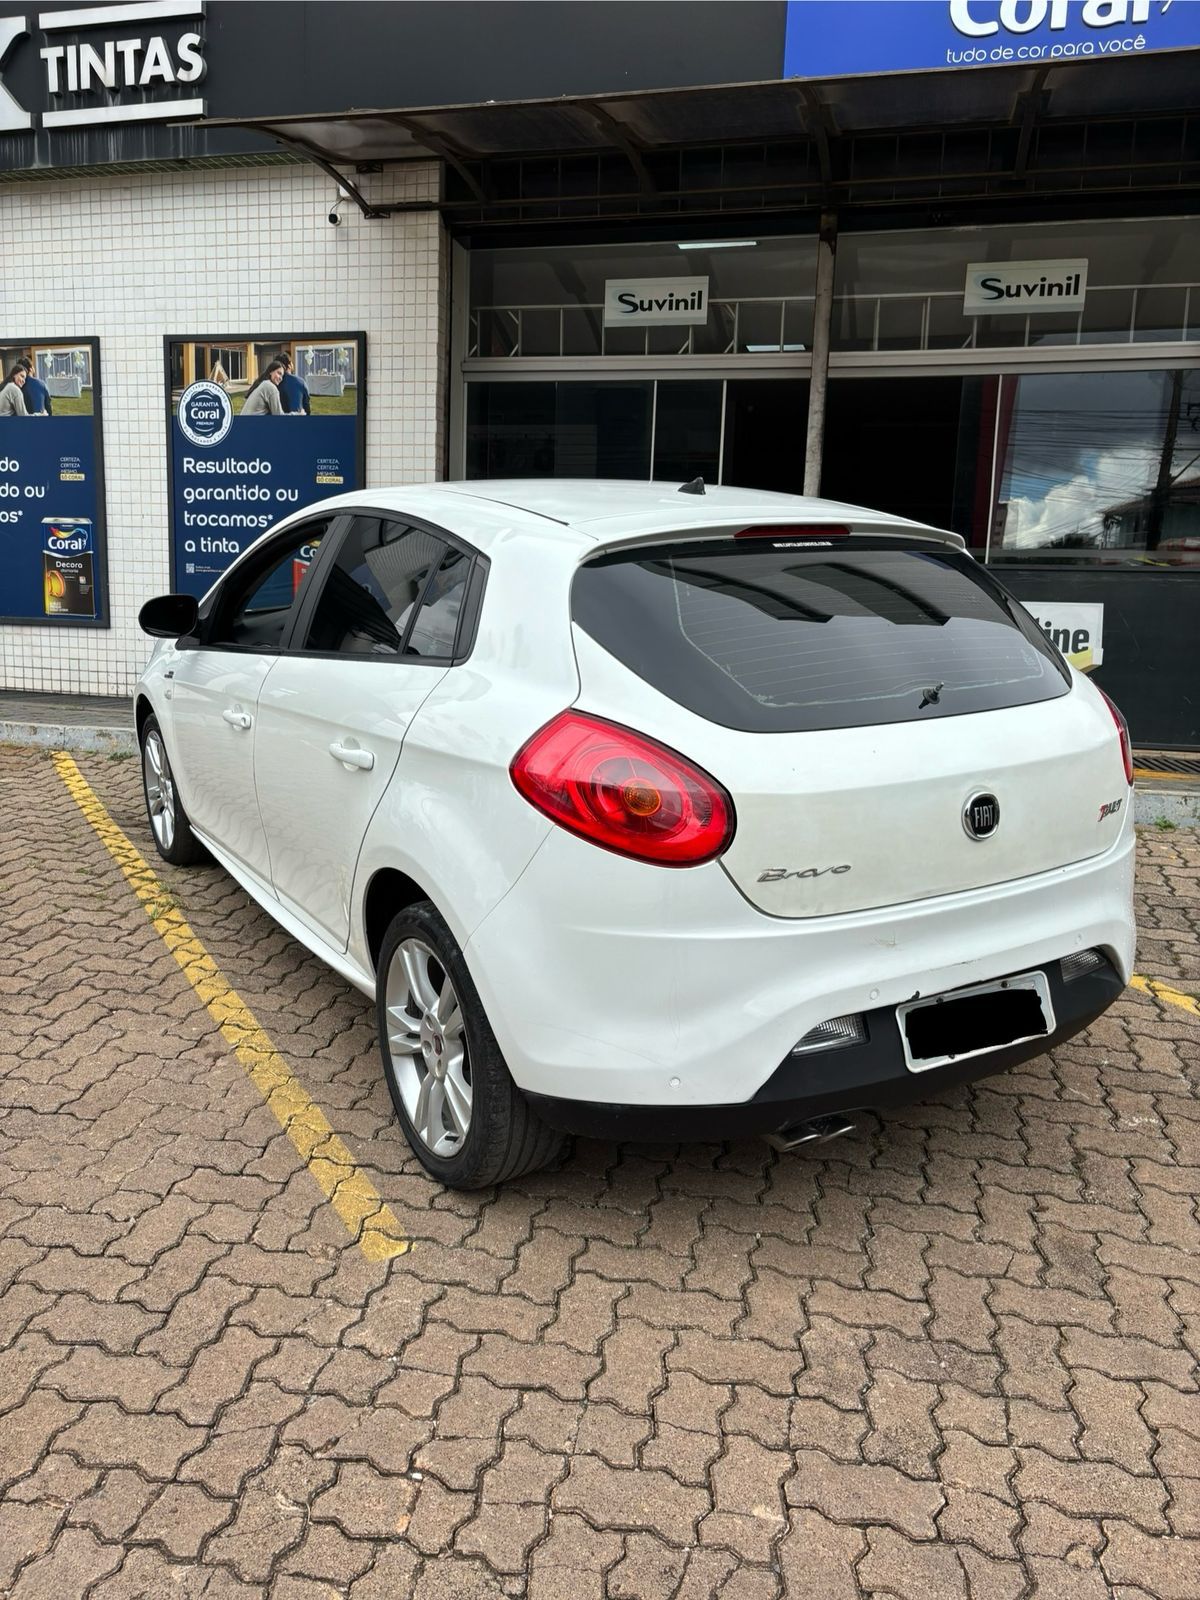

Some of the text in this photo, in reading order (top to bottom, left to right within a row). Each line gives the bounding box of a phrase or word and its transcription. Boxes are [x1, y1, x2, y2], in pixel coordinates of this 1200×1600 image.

[946, 34, 1146, 63] tudo de cor para você
[40, 33, 204, 93] TINTAS
[980, 274, 1080, 300] Suvinil
[617, 290, 703, 314] Suvinil
[190, 408, 220, 420] Coral
[183, 457, 272, 475] Resultado
[24, 485, 45, 498] ou
[183, 485, 299, 503] garantido ou
[48, 536, 82, 550] Coral
[184, 537, 240, 553] a tinta
[55, 561, 83, 569] Decora
[974, 804, 994, 828] FIAT
[757, 864, 851, 882] Bravo
